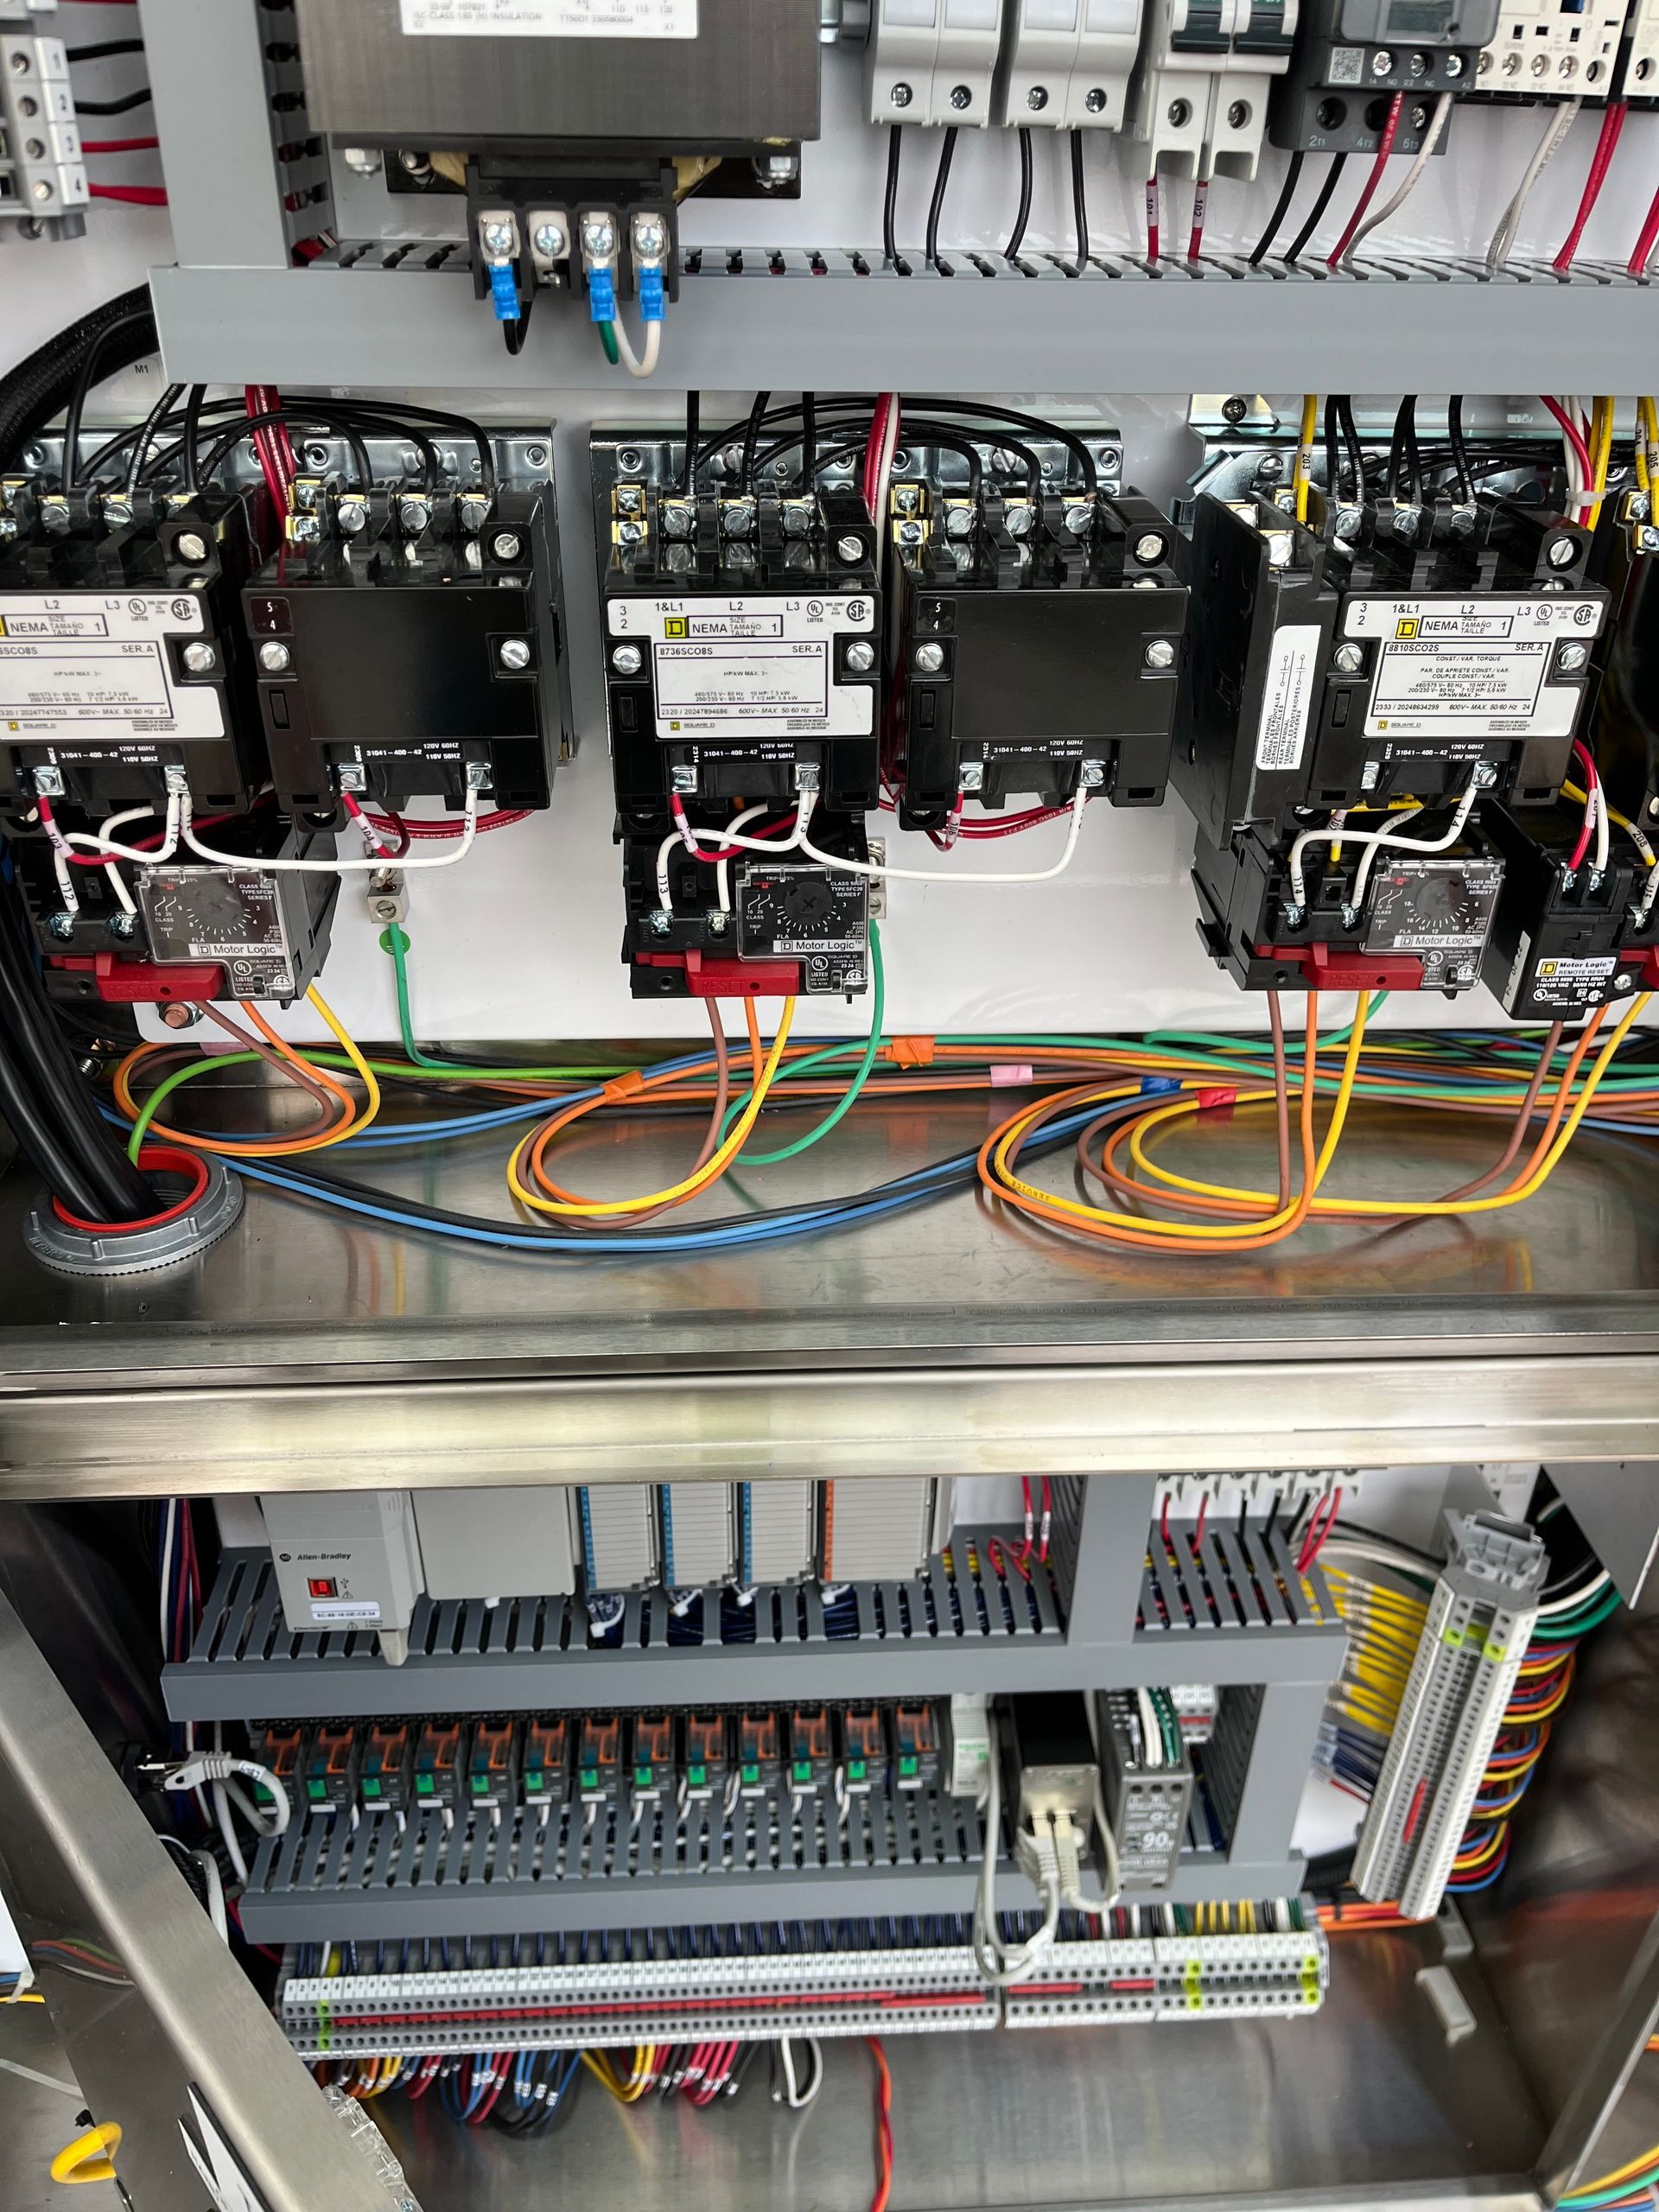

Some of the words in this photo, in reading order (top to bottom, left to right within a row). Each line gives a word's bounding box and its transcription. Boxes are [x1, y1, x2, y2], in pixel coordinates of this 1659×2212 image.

[1194, 200, 1203, 217] 102
[134, 365, 149, 374] M1
[1301, 453, 1311, 470] 203
[1649, 451, 1659, 469] 205
[45, 600, 60, 610] L2
[105, 601, 120, 610] L3
[267, 602, 273, 613] 5
[620, 606, 626, 615] 3
[655, 602, 683, 612] 1&L1
[729, 601, 743, 611] L2
[786, 602, 800, 612] L3
[935, 602, 941, 613] 5
[1360, 603, 1367, 613] 3
[1392, 605, 1420, 613] 1&L1
[1461, 605, 1475, 614] L2
[1517, 607, 1531, 616] L3
[10, 622, 48, 632] NEMA
[95, 622, 101, 632] 1
[50, 621, 84, 630] TAMAÑO
[270, 620, 276, 630] 4
[620, 620, 628, 629] 2
[933, 620, 938, 630] 4
[1358, 616, 1365, 626] 2
[1425, 621, 1459, 631] NEMA
[1501, 621, 1506, 630] 1
[692, 623, 728, 633] NEMA
[772, 623, 777, 632] 1
[1264, 715, 1273, 743] TERMINAL
[1281, 719, 1290, 747] TERMINAL
[1451, 806, 1465, 827] 114
[169, 823, 180, 844] 112
[360, 826, 375, 842] 104
[949, 823, 958, 836] 106
[48, 832, 62, 849] 103
[1633, 830, 1648, 847] 208
[658, 874, 669, 893] 113
[1294, 876, 1303, 893] 114
[60, 881, 74, 900] 112
[213, 945, 244, 954] Motor
[796, 941, 824, 950] Motor
[1328, 973, 1372, 987] RESET
[701, 980, 746, 994] RESET
[297, 1553, 351, 1561] Allen-Bradley
